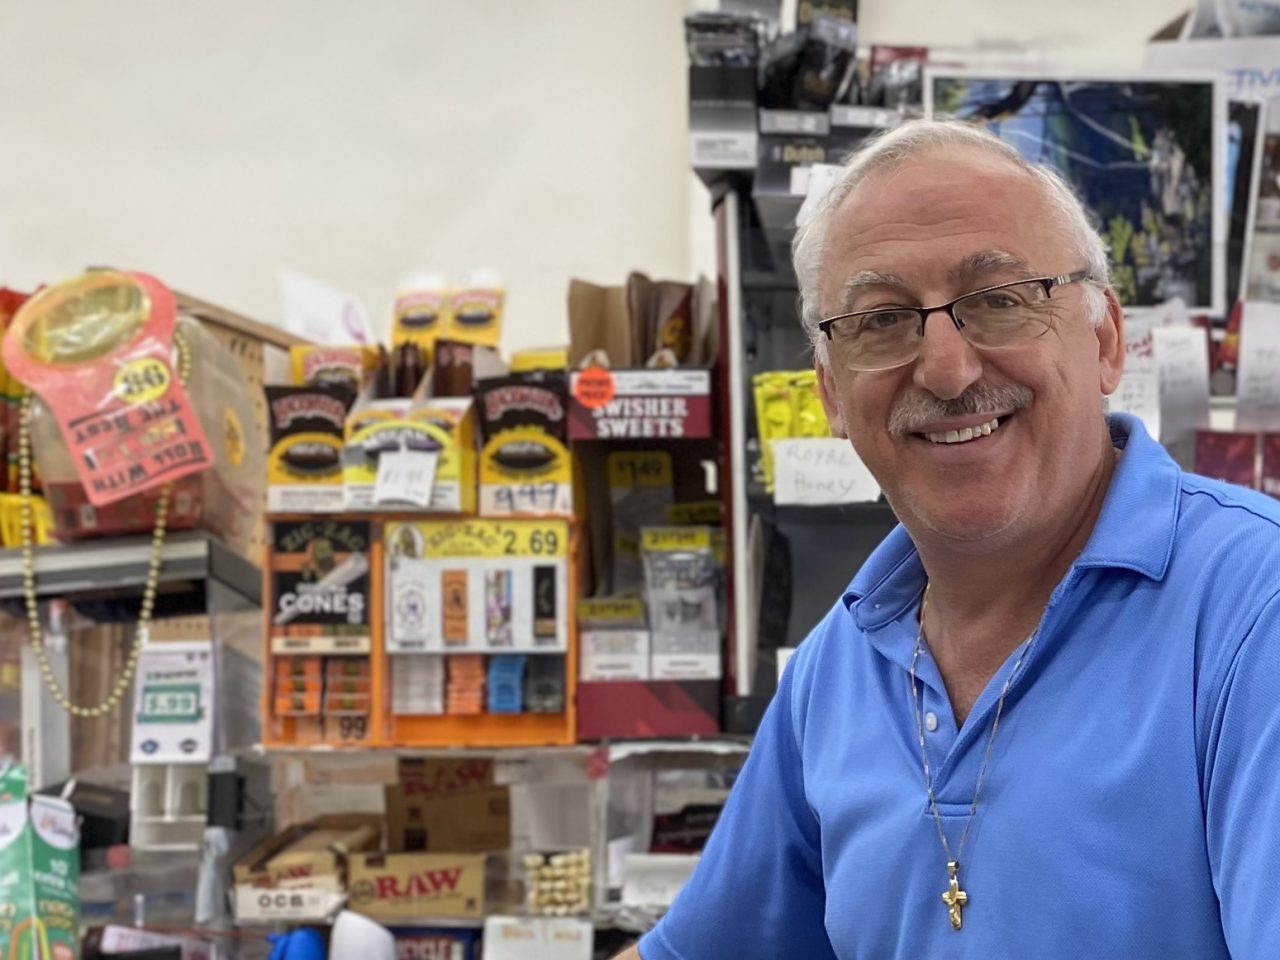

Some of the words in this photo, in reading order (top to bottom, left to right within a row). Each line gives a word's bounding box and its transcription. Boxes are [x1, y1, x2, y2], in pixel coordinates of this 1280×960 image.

[597, 418, 684, 438] SWEETS
[278, 593, 366, 614] CONES
[374, 867, 464, 900] RAW
